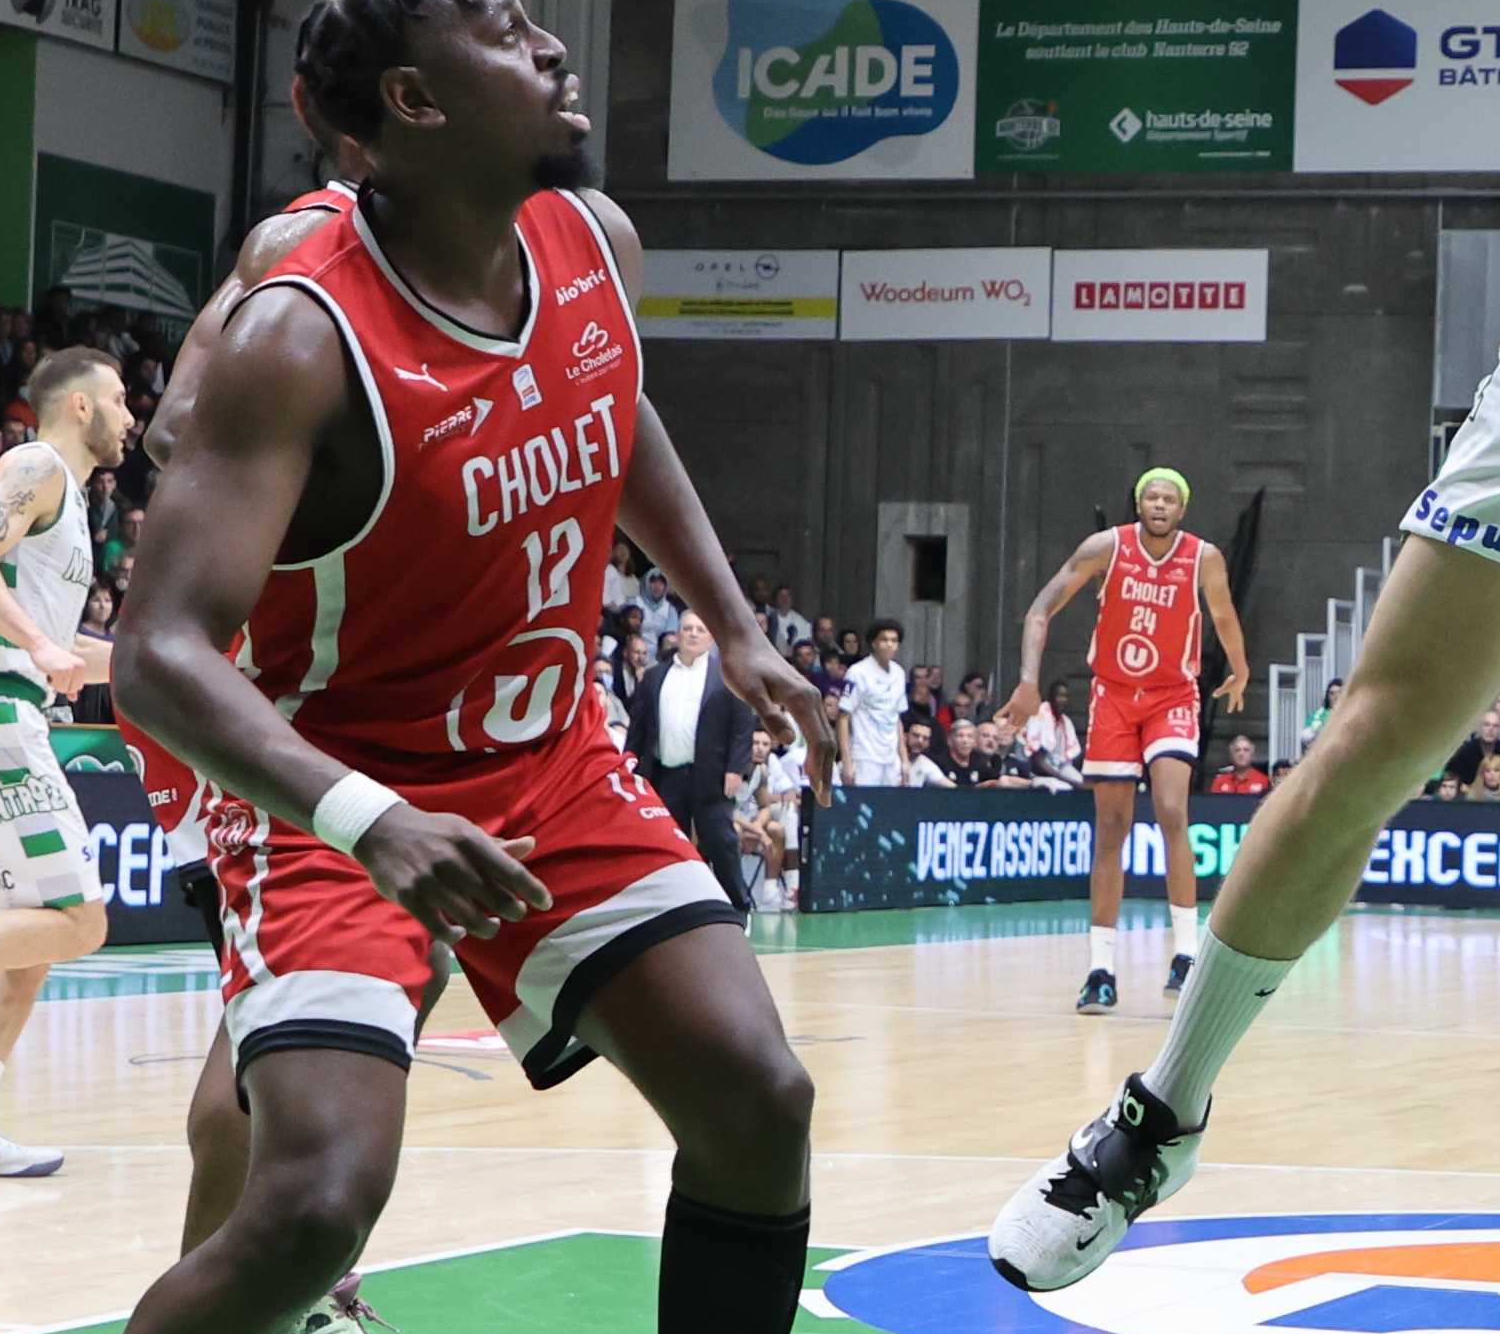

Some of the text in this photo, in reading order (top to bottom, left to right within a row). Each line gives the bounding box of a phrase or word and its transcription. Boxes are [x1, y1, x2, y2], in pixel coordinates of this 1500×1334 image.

[1155, 17, 1283, 35] Hauts-de-Seine
[1111, 43, 1147, 58] club
[1153, 42, 1226, 58] Nanterre
[737, 45, 936, 99] ICADE
[1146, 109, 1272, 129] hauts-de-seine
[860, 279, 975, 303] Woodeum
[1074, 281, 1246, 310] LAMOTTE
[565, 343, 624, 380] Le Choletais
[462, 393, 621, 538] CHOLET
[520, 518, 585, 624] 12
[1121, 576, 1179, 608] CHOLET
[1129, 605, 1158, 636] 24
[917, 822, 989, 880] VENEZ
[991, 820, 1092, 878] ASSISTER
